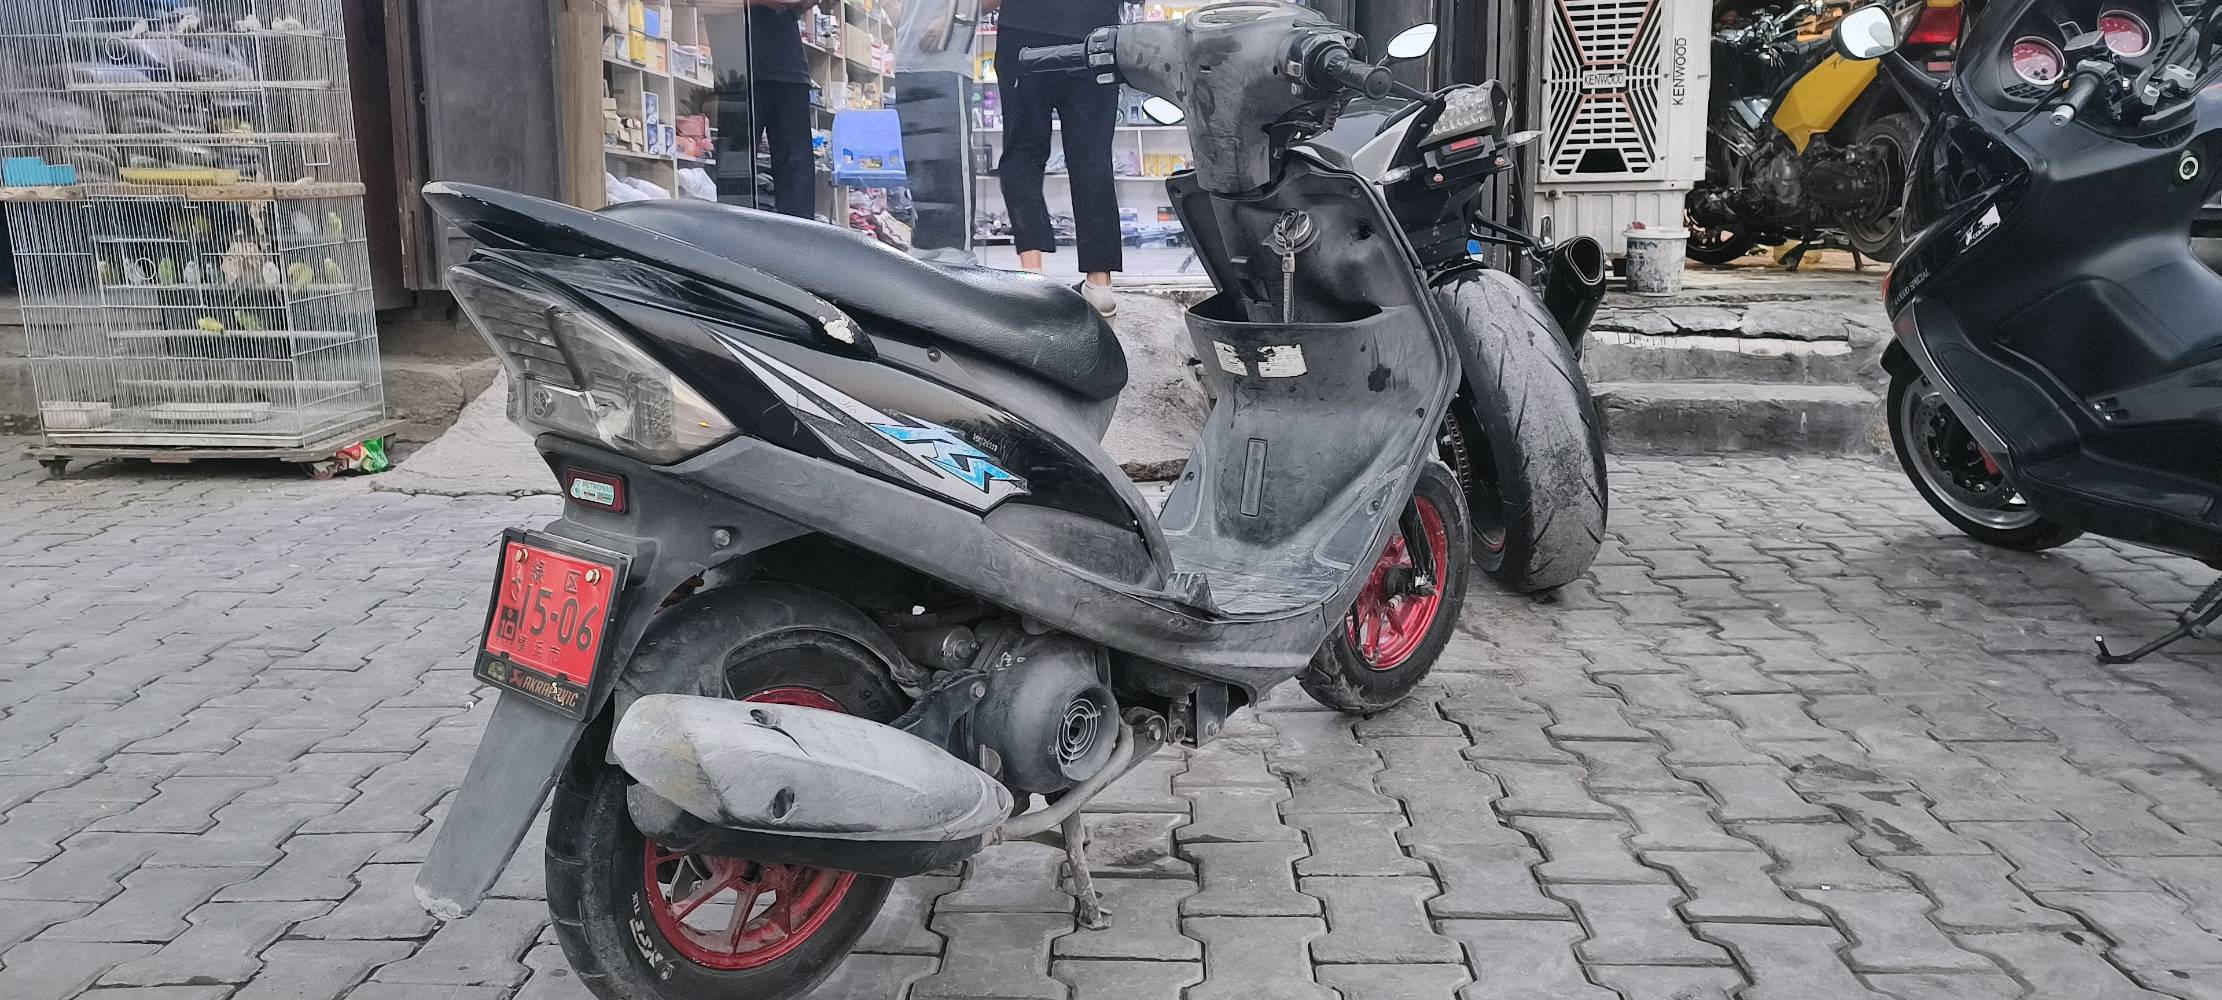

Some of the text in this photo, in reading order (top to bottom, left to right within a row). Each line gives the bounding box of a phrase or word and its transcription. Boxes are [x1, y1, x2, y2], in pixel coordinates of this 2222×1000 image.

[1584, 72, 1625, 86] KENWOOD
[1672, 36, 1687, 106] KENWOOD
[518, 583, 599, 651] 15-06
